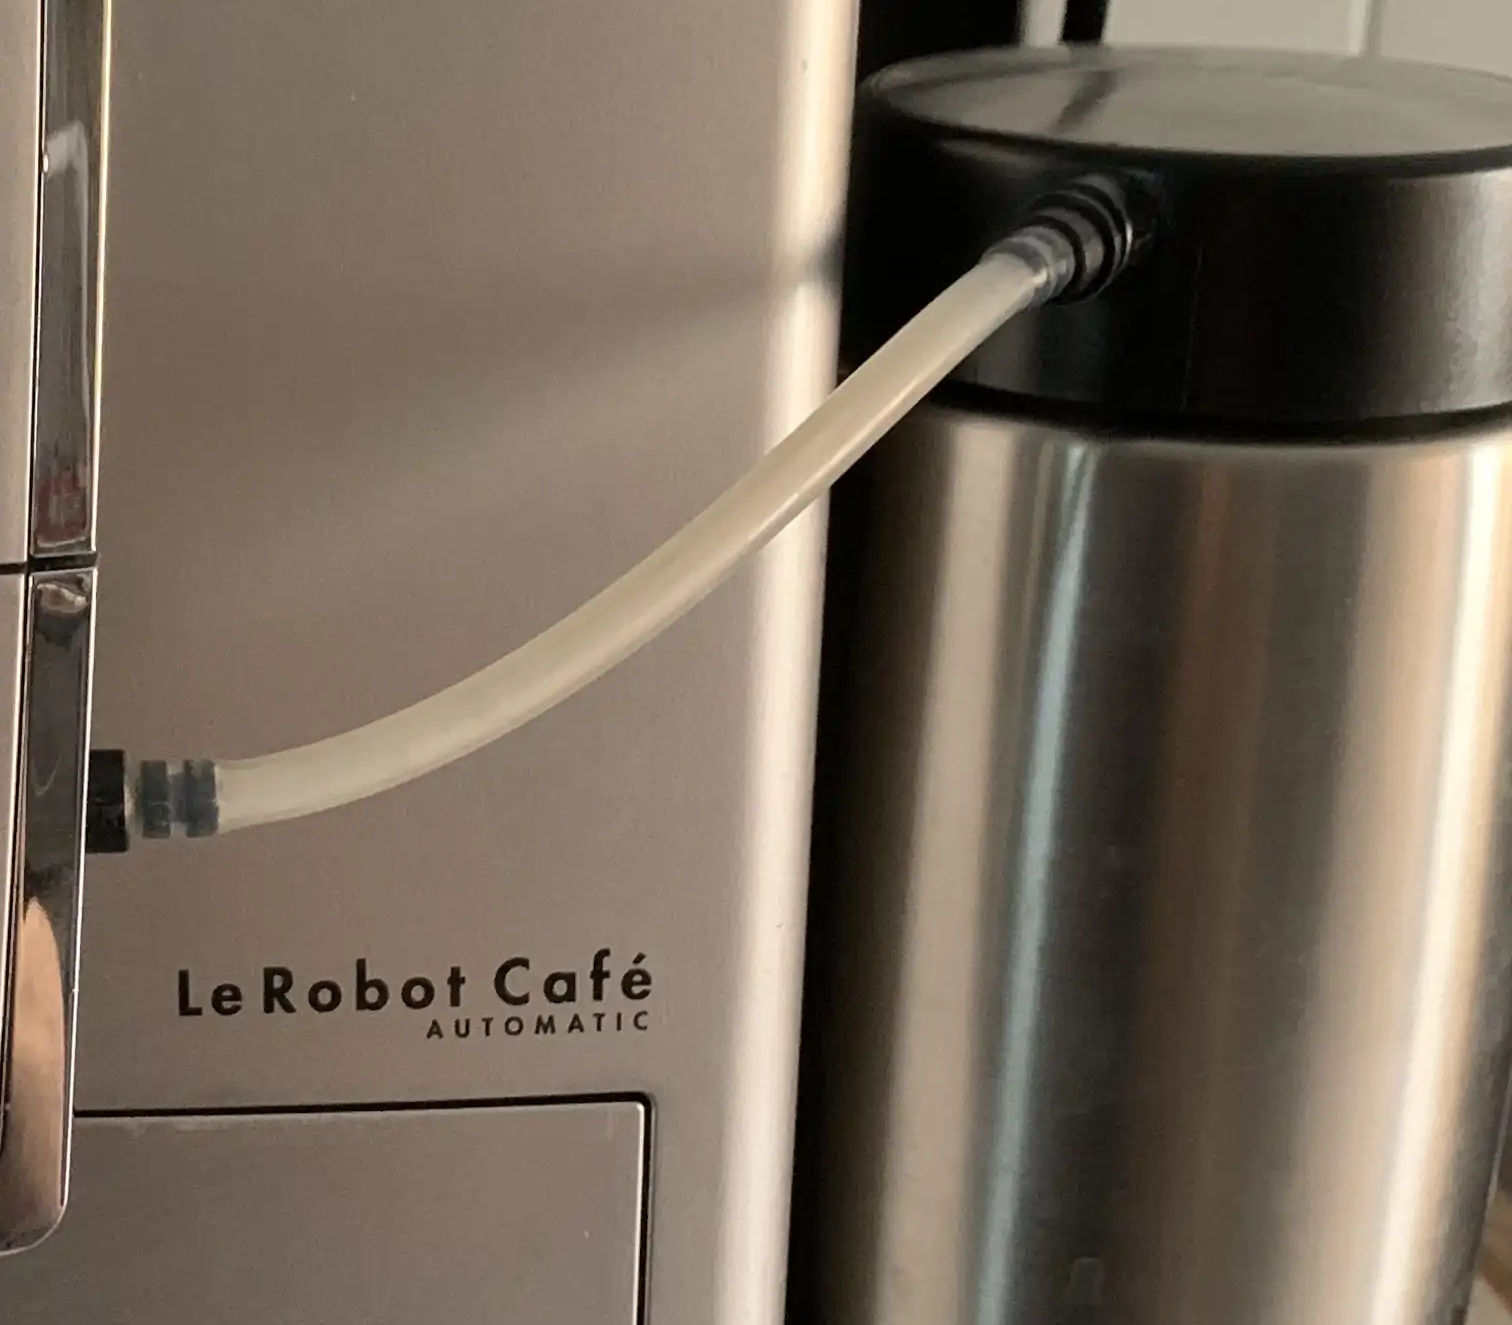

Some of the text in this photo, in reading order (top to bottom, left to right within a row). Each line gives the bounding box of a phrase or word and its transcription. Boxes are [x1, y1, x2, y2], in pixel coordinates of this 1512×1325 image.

[177, 947, 653, 1017] Le Robot Café
[425, 1009, 649, 1040] AUTOMATIC
